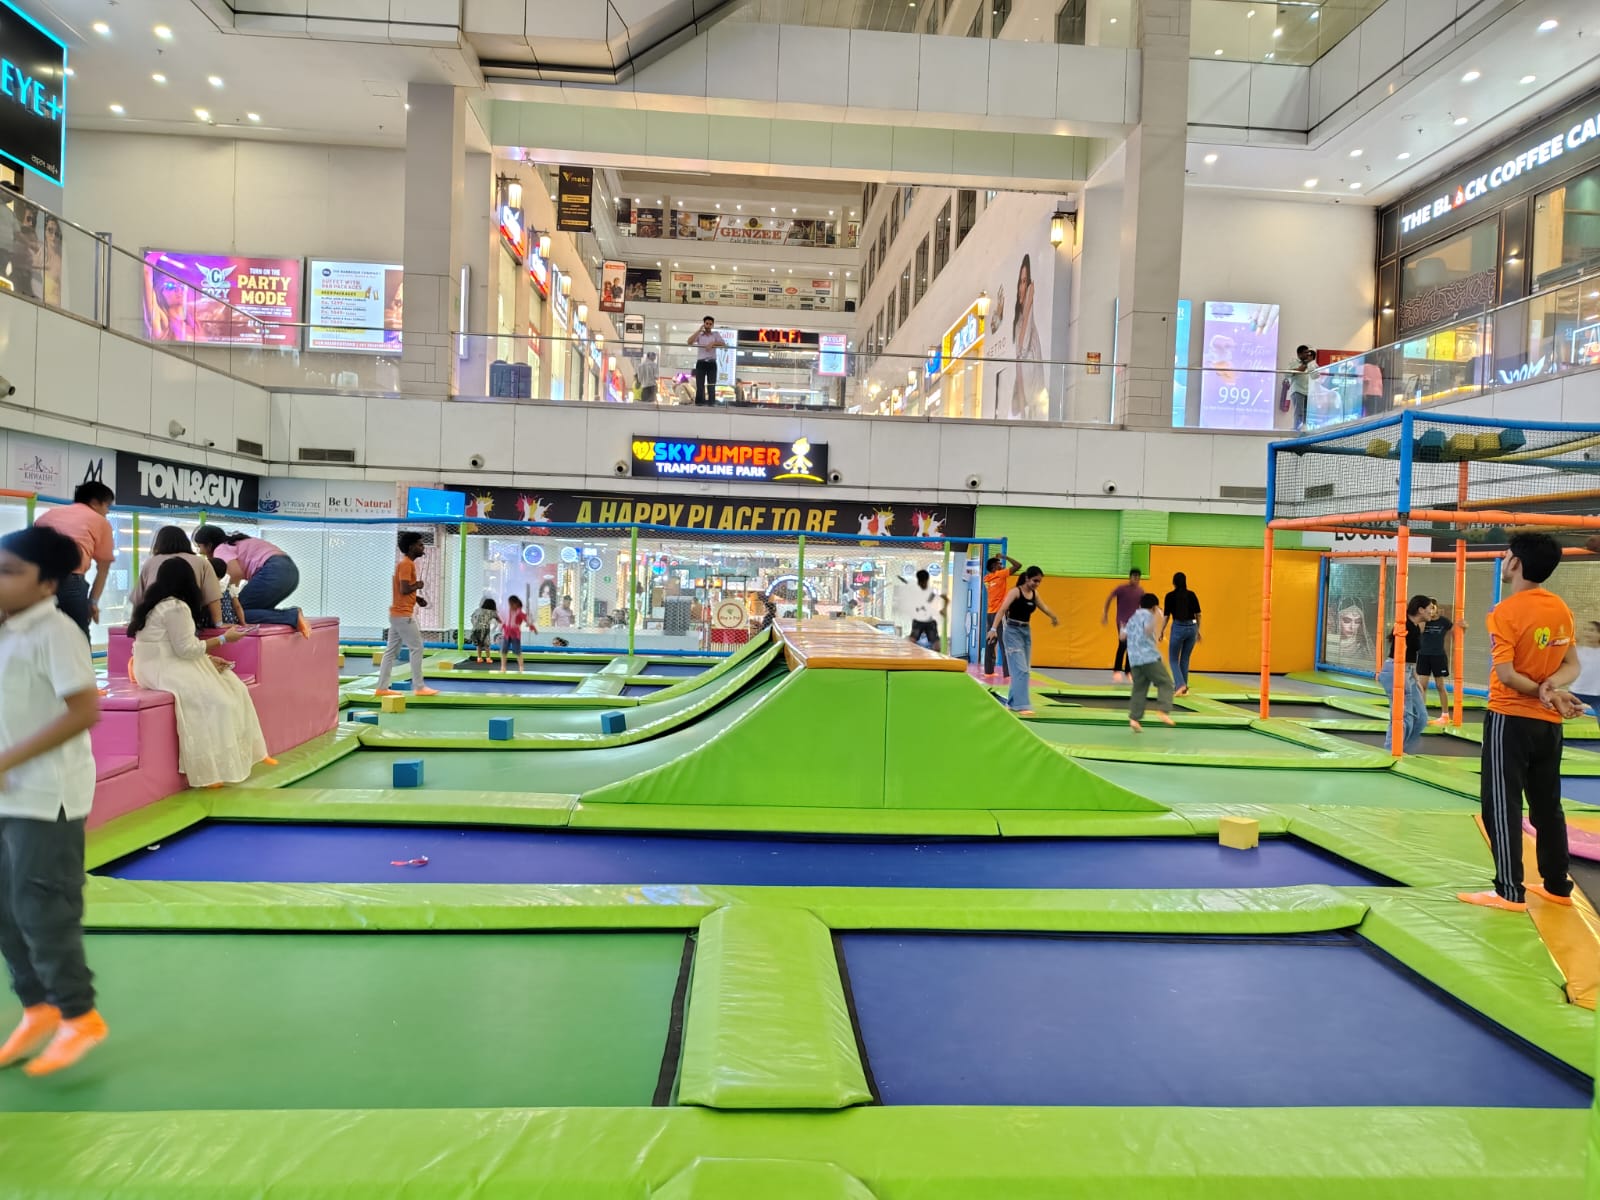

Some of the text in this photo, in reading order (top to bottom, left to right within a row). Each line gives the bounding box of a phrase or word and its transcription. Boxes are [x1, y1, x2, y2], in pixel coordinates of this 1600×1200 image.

[1401, 203, 1432, 233] THE
[1489, 133, 1565, 189] COFFEE
[720, 227, 782, 240] GENZEE
[237, 274, 292, 291] PARTY
[241, 289, 287, 306] MODE
[1218, 386, 1270, 406] 999/-
[656, 462, 767, 477] TRAMPOLINE PARK
[138, 460, 244, 509] TONI&GUY
[328, 496, 392, 510] Be U Natural
[576, 501, 592, 524] A
[600, 501, 684, 528] HAPPY
[687, 504, 767, 531] PLACE
[771, 508, 800, 531] TO
